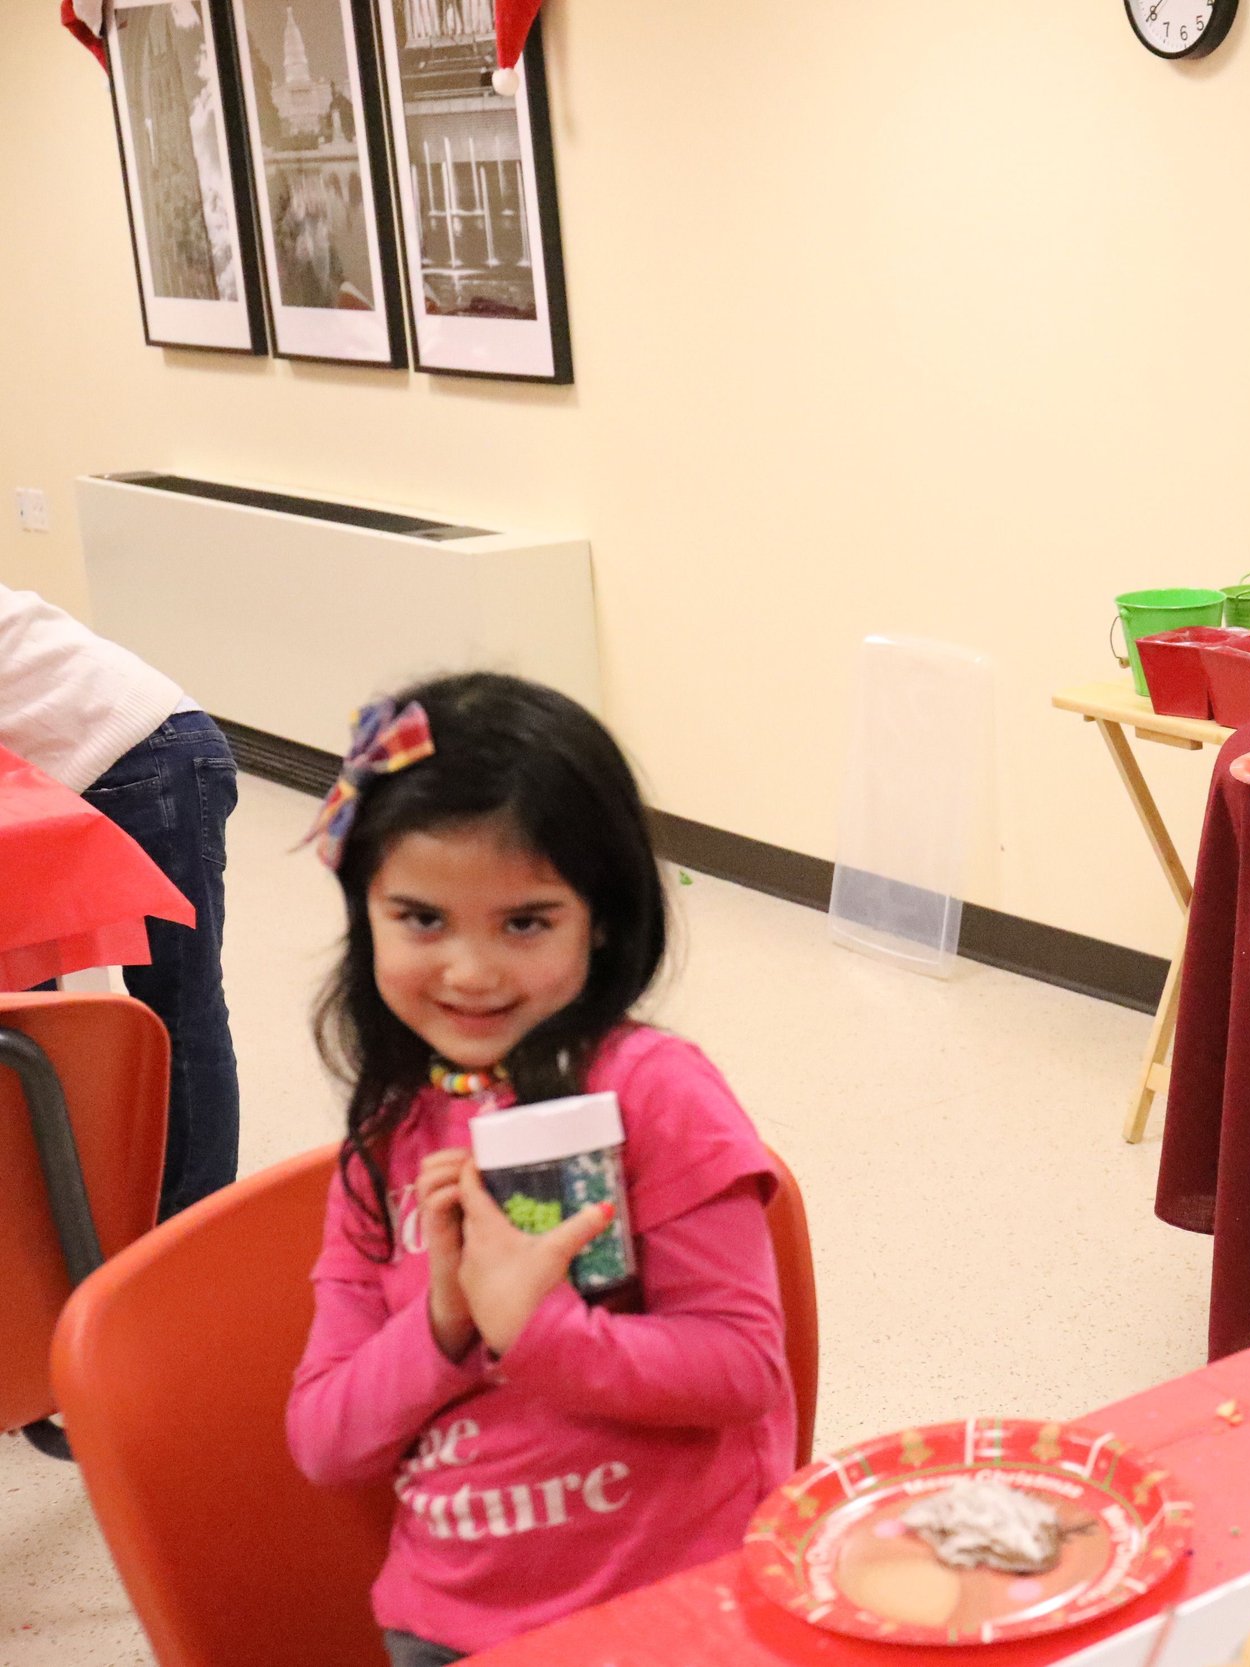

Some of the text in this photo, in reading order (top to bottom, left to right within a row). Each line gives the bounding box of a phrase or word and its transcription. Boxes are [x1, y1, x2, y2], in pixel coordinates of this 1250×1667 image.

[1149, 5, 1158, 21] 8
[1162, 21, 1171, 38] 7
[1196, 15, 1205, 31] 5
[1180, 25, 1188, 41] 6
